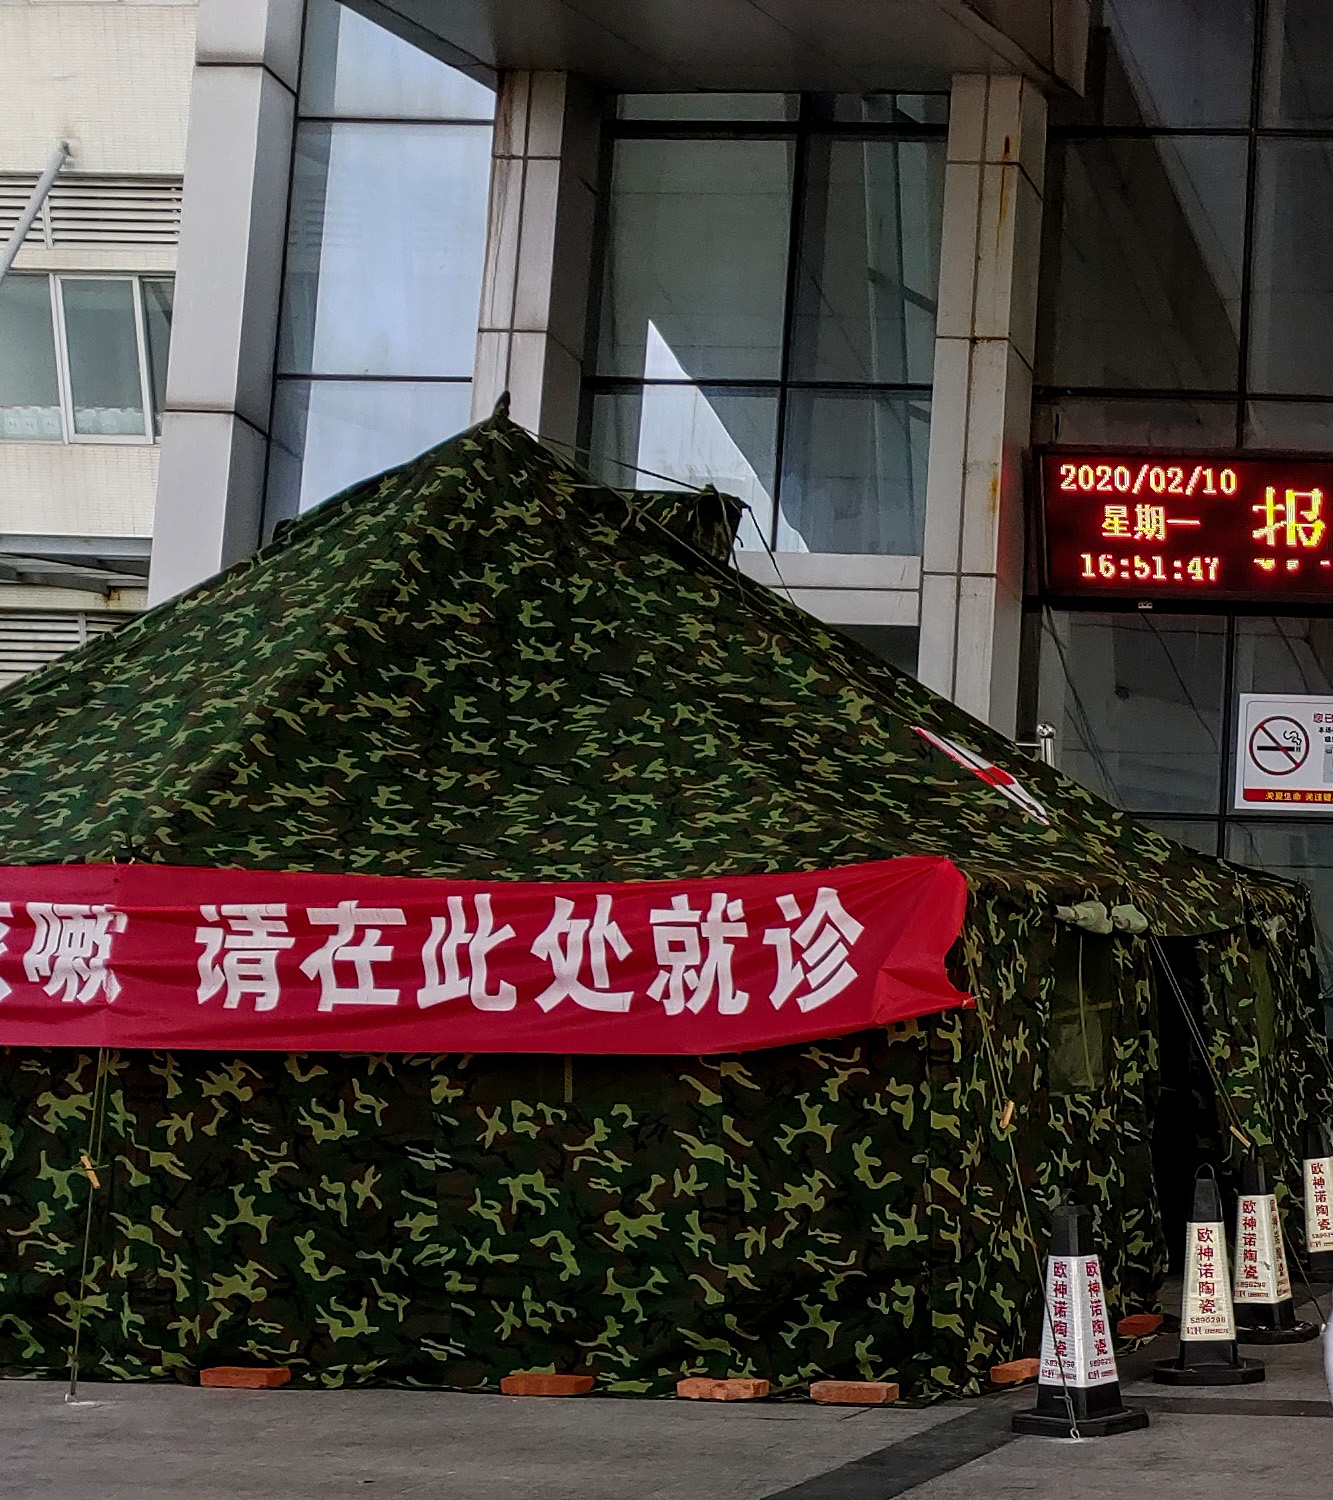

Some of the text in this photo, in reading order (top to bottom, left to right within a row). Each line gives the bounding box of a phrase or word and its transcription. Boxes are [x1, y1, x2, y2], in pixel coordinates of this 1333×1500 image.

[1060, 463, 1238, 496] 2020/02/10
[1101, 503, 1201, 541] 星期一
[1080, 552, 1221, 582] 16:51:47
[194, 886, 866, 1014] 请在此处就诊
[1197, 1227, 1217, 1315] 欧神诺陶瓷
